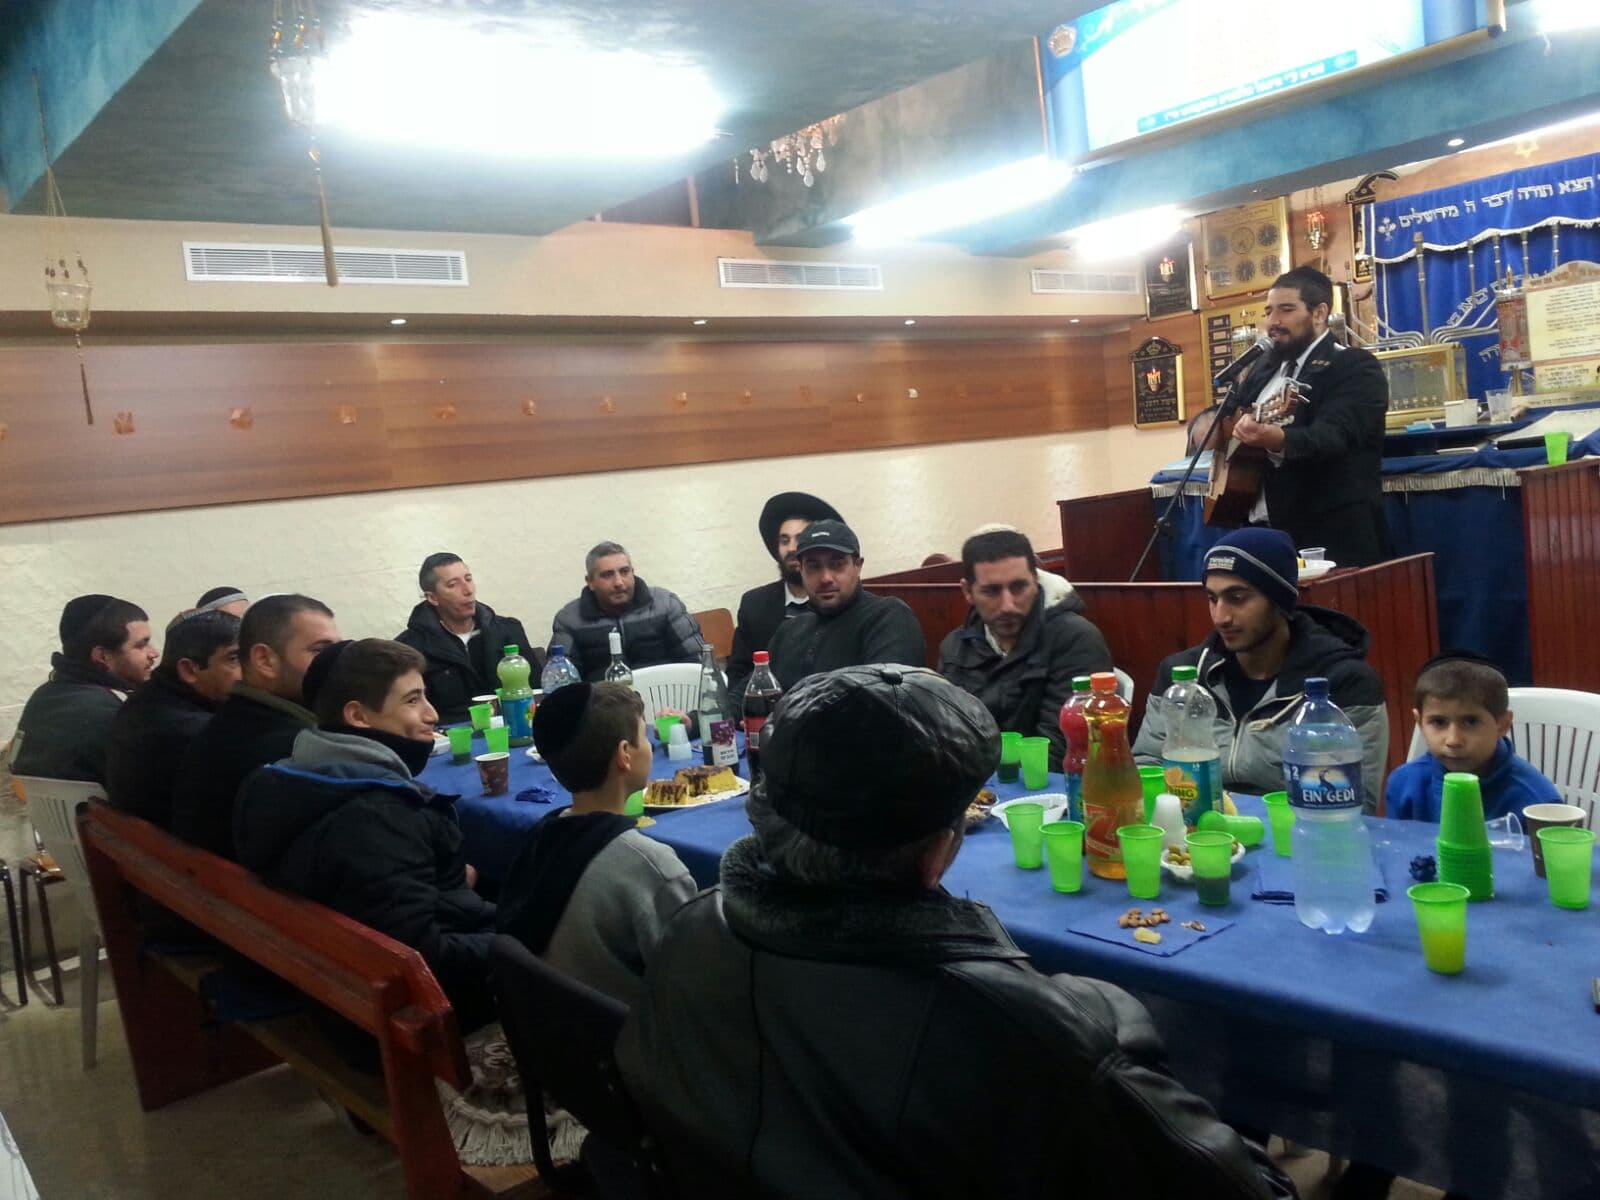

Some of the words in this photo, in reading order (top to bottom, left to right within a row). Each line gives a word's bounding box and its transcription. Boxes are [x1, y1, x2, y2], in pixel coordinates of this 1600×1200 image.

[1517, 184, 1554, 200] תורה
[1558, 176, 1594, 195] תצא
[1398, 205, 1460, 228] מירושלים
[1302, 789, 1322, 803] EIN
[1326, 788, 1356, 802] GEDI
